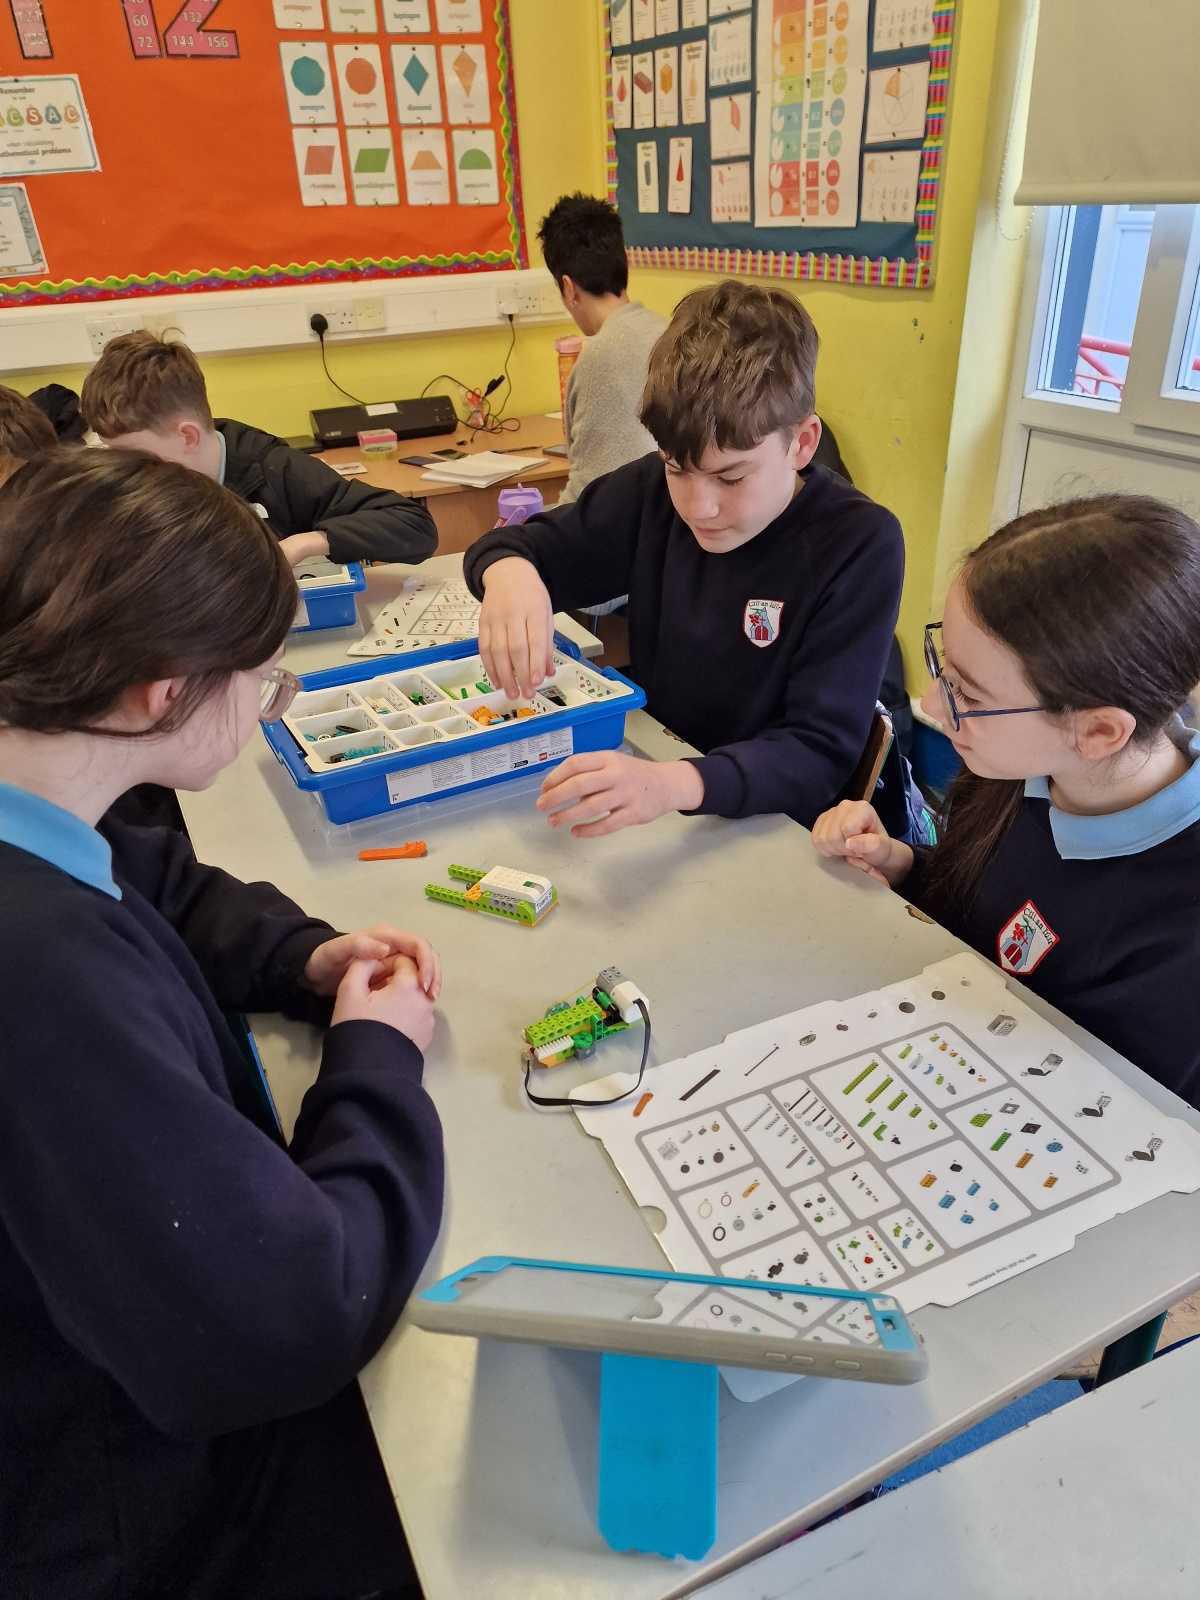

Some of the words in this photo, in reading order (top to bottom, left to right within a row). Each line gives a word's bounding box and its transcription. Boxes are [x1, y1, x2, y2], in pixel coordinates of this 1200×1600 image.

[132, 15, 149, 27] 60
[137, 36, 153, 48] 72
[207, 36, 229, 48] 156
